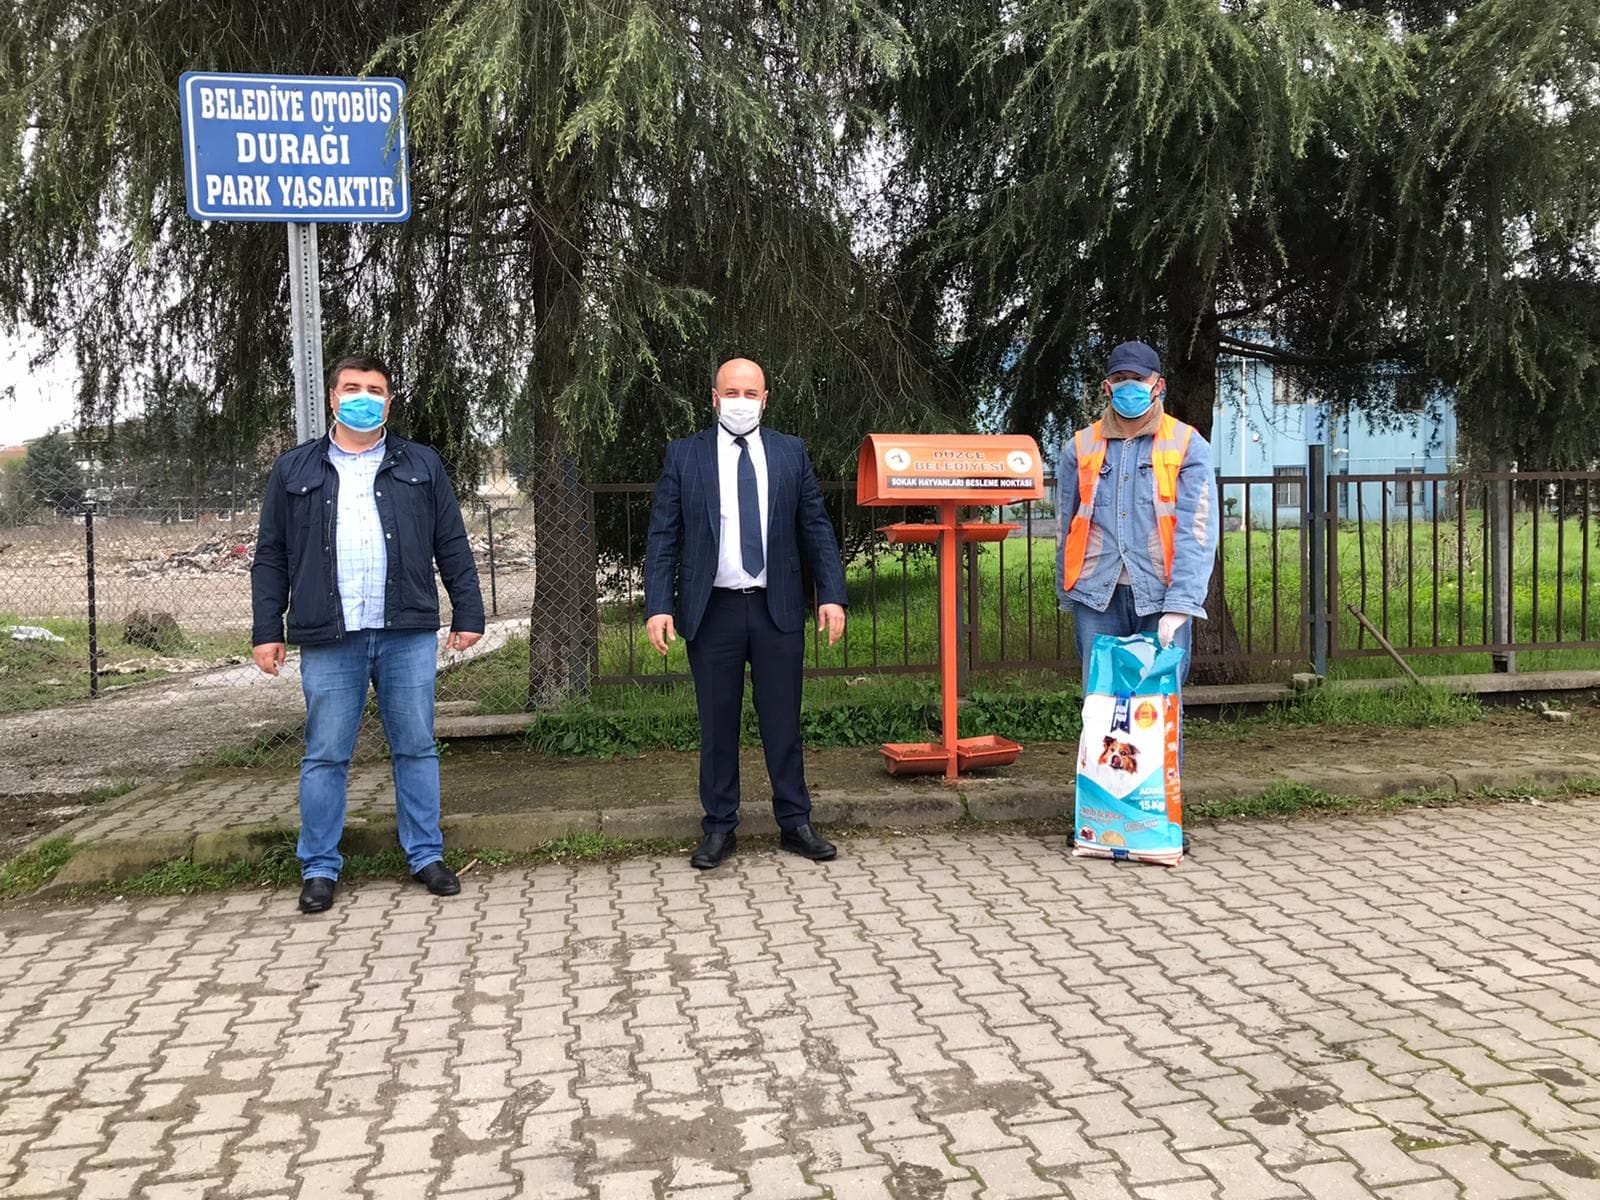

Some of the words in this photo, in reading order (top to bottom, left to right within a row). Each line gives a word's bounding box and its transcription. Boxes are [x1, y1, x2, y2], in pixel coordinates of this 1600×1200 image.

[200, 86, 304, 122] BELEDİYE
[311, 88, 392, 123] OTOBÜS
[236, 125, 350, 165] DURAĞI
[206, 175, 272, 205] PARK
[278, 175, 395, 206] YASAKTIR
[891, 478, 917, 486] SOKAK
[918, 478, 964, 487] HAYVANLARI
[965, 479, 999, 487] BESLEME
[1000, 479, 1032, 487] NOKTASI
